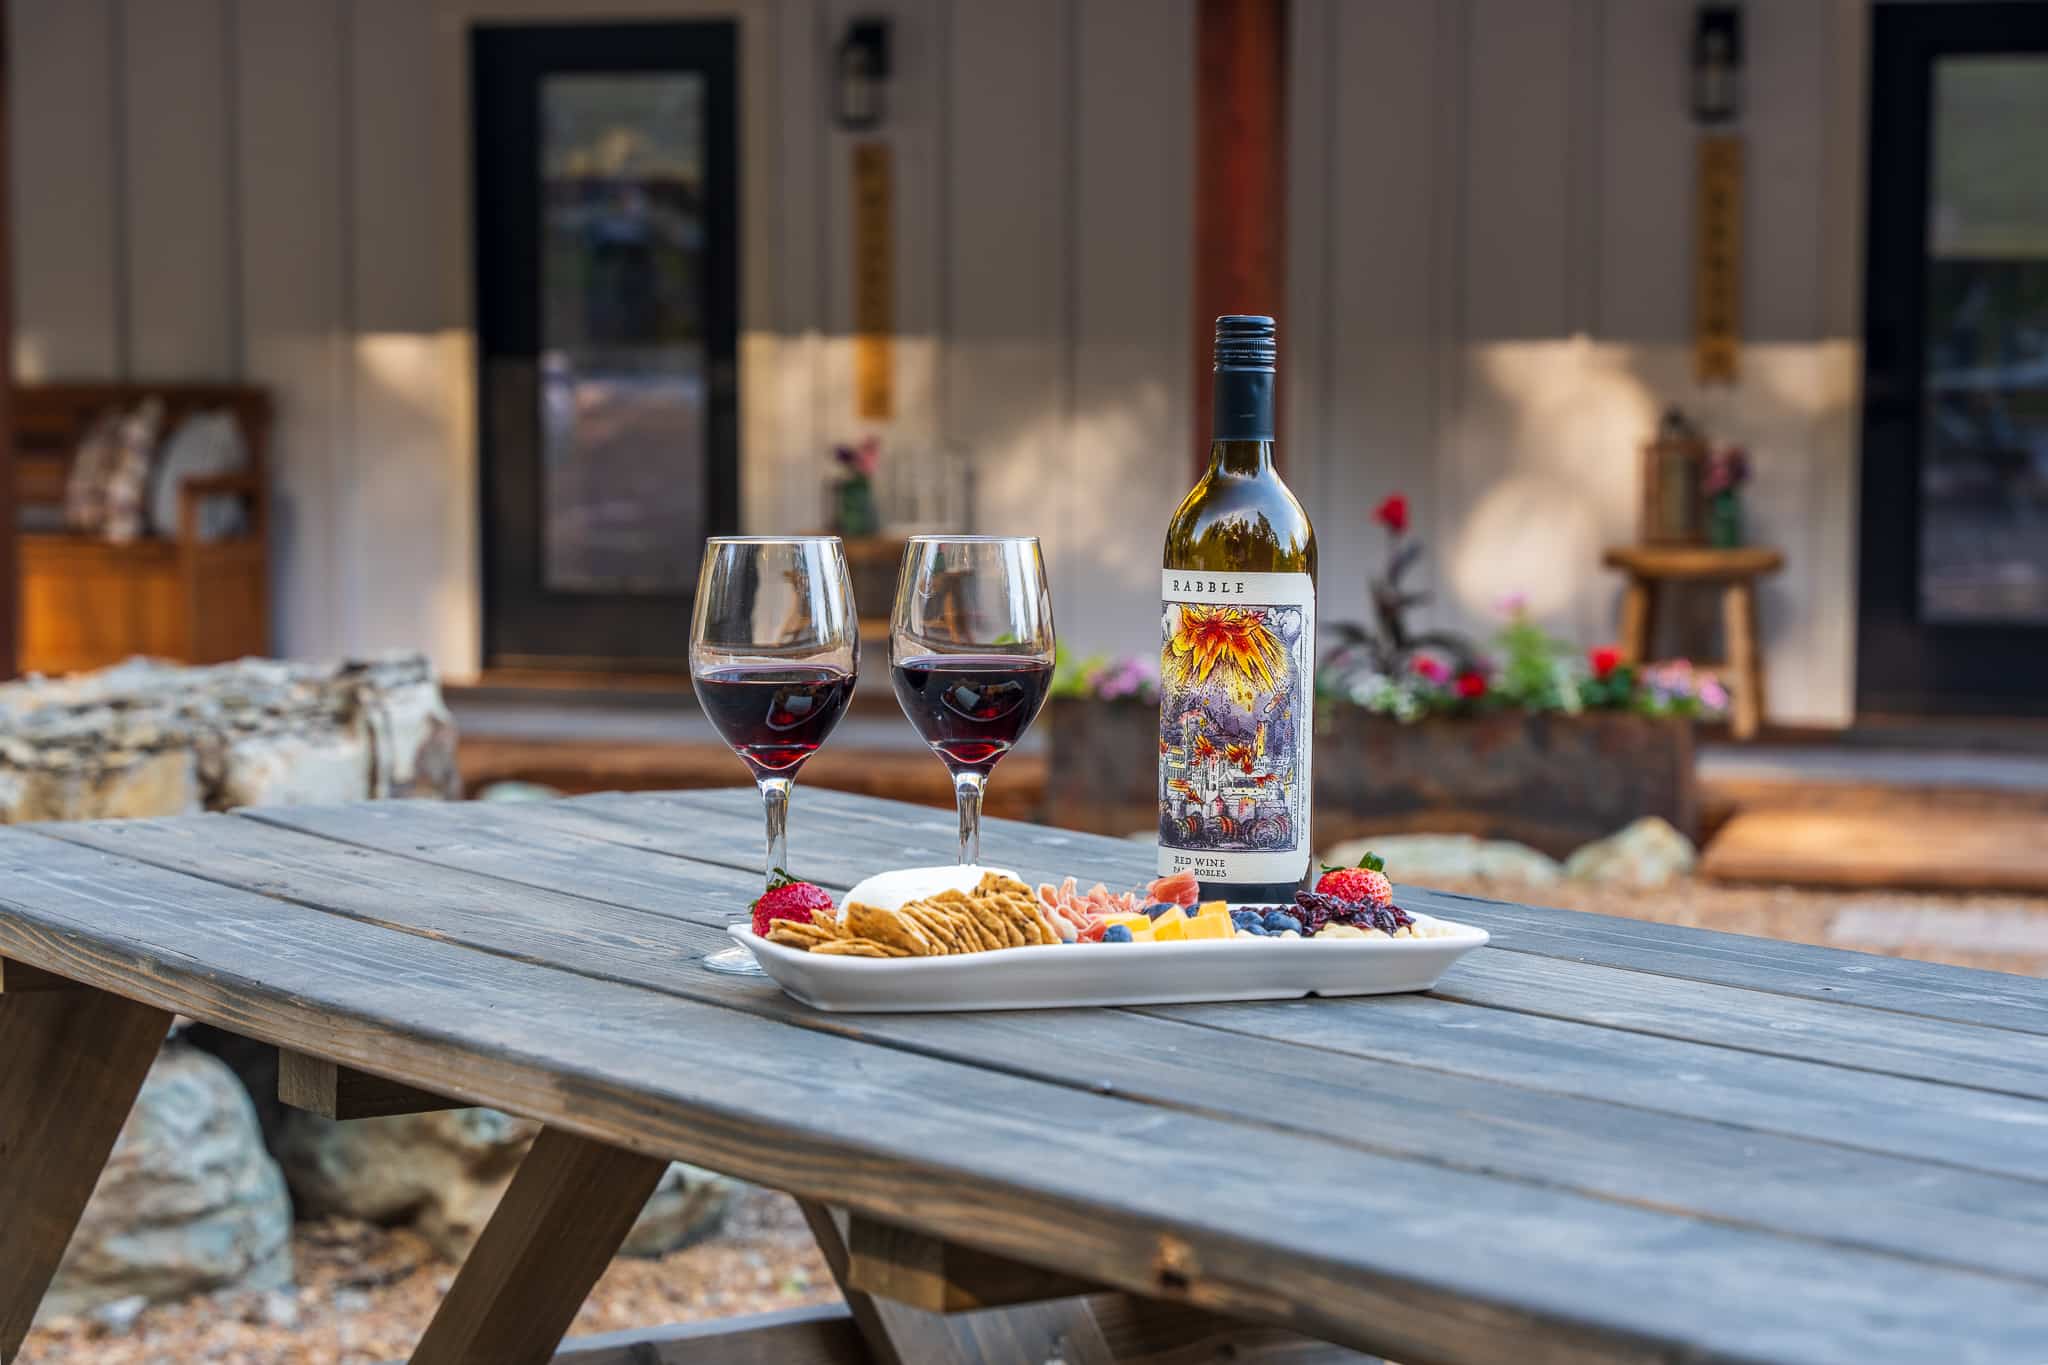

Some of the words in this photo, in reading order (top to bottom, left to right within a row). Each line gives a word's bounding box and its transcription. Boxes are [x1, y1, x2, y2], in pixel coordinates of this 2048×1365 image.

[1173, 580, 1244, 593] RABBLE
[1174, 855, 1191, 864] RED
[1195, 857, 1225, 868] WINE
[1194, 868, 1227, 877] ROBLES
